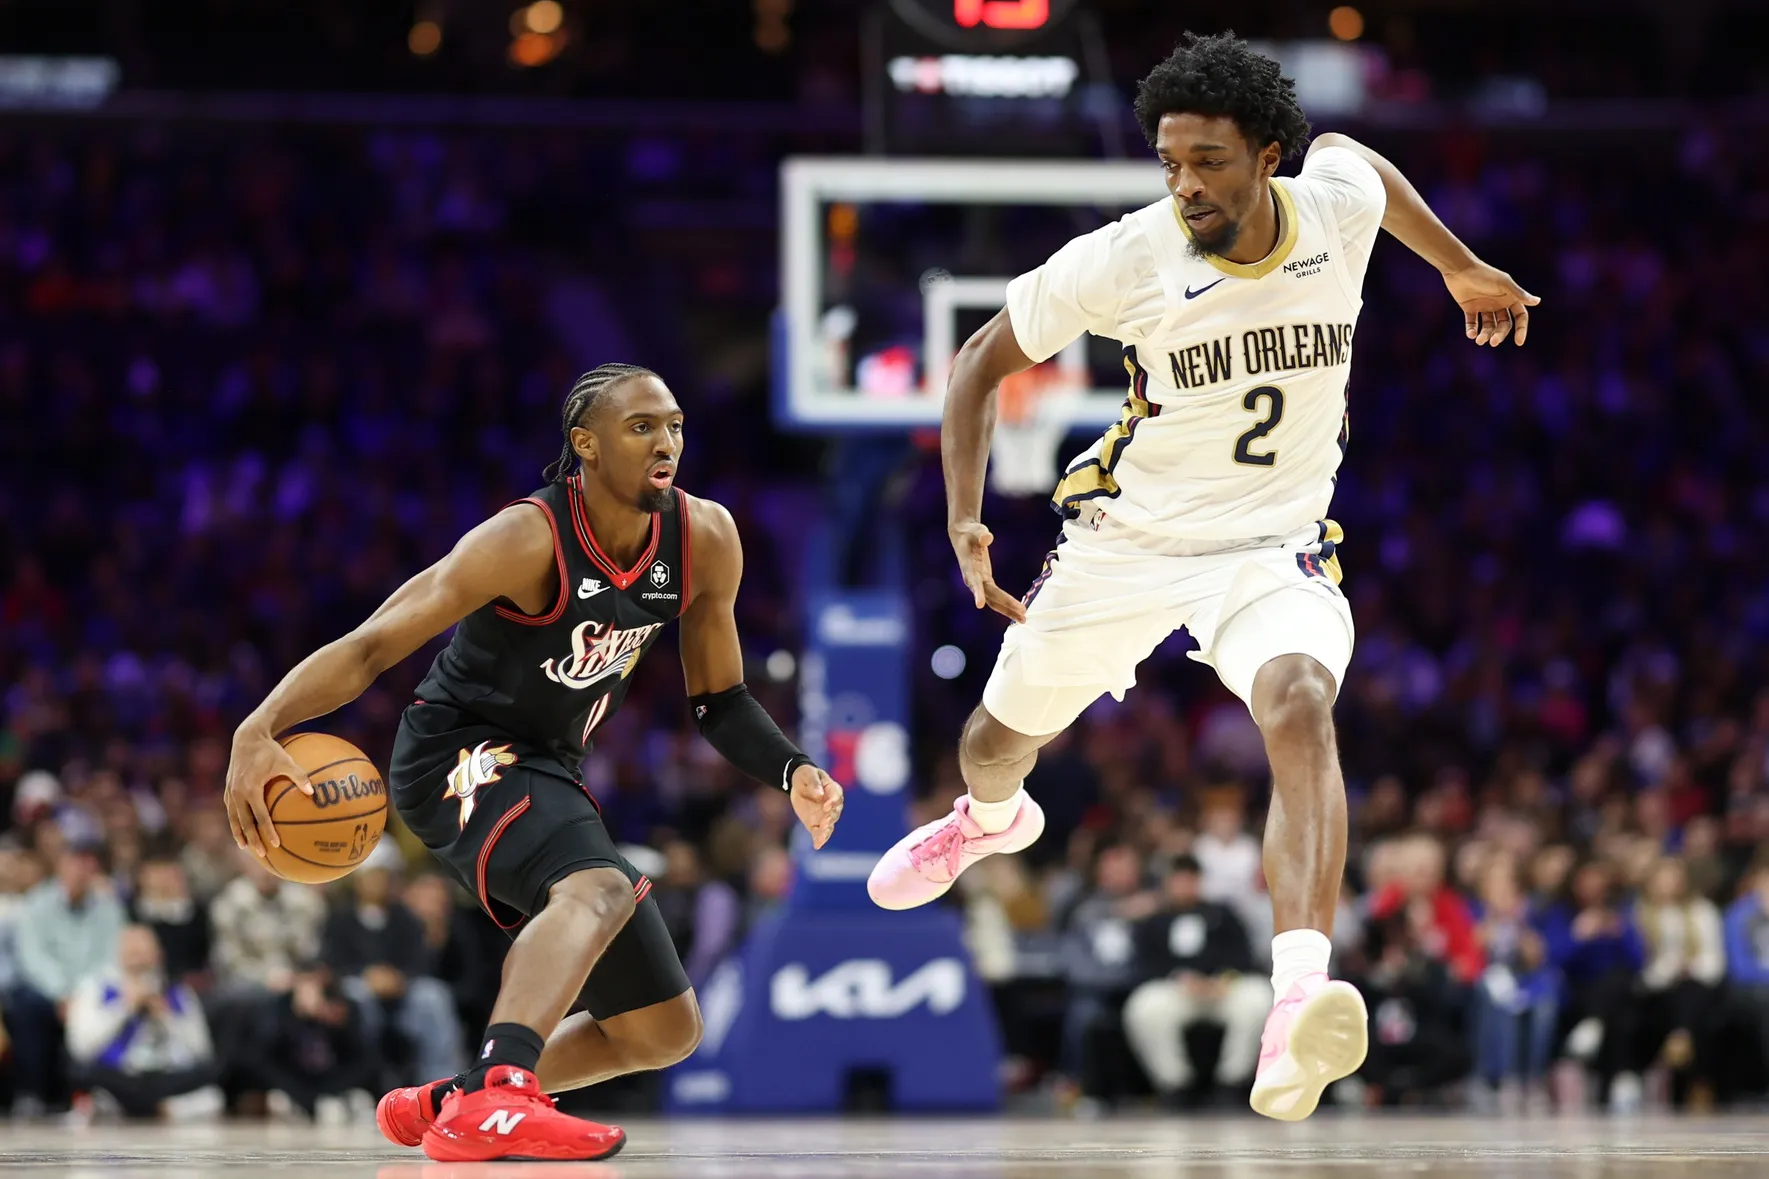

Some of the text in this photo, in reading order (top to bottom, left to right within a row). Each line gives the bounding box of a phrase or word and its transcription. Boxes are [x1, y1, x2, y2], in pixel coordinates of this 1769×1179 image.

[1283, 252, 1330, 274] NEWAGE
[1296, 267, 1321, 279] GRILLS
[1168, 324, 1352, 389] NEW ORLEANS
[1231, 384, 1286, 467] 2
[582, 578, 601, 592] NIKE
[641, 592, 678, 601] crypto.com
[312, 773, 385, 808] Wilson
[478, 1109, 526, 1135] N
